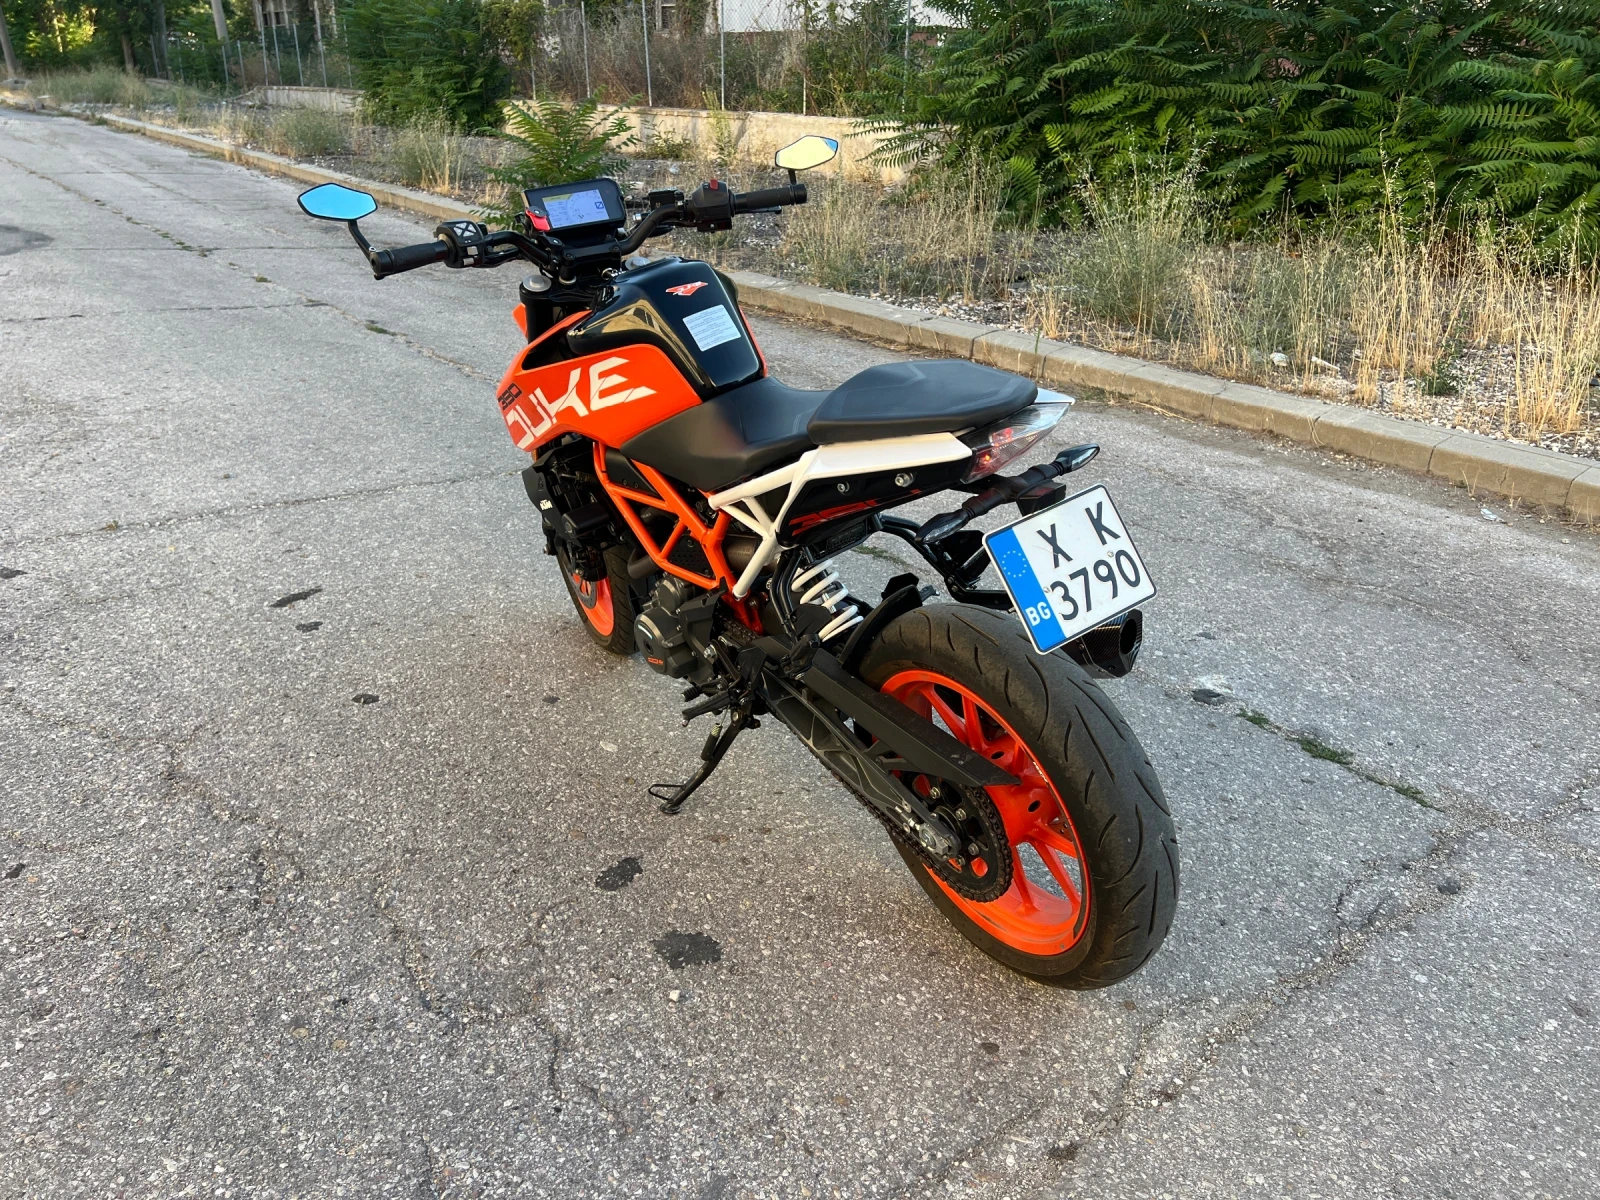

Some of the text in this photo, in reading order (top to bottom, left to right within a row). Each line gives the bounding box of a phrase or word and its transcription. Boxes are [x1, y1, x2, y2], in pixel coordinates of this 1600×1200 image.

[1036, 501, 1121, 569] X K
[1025, 601, 1052, 627] BG
[1050, 549, 1141, 621] 3790
